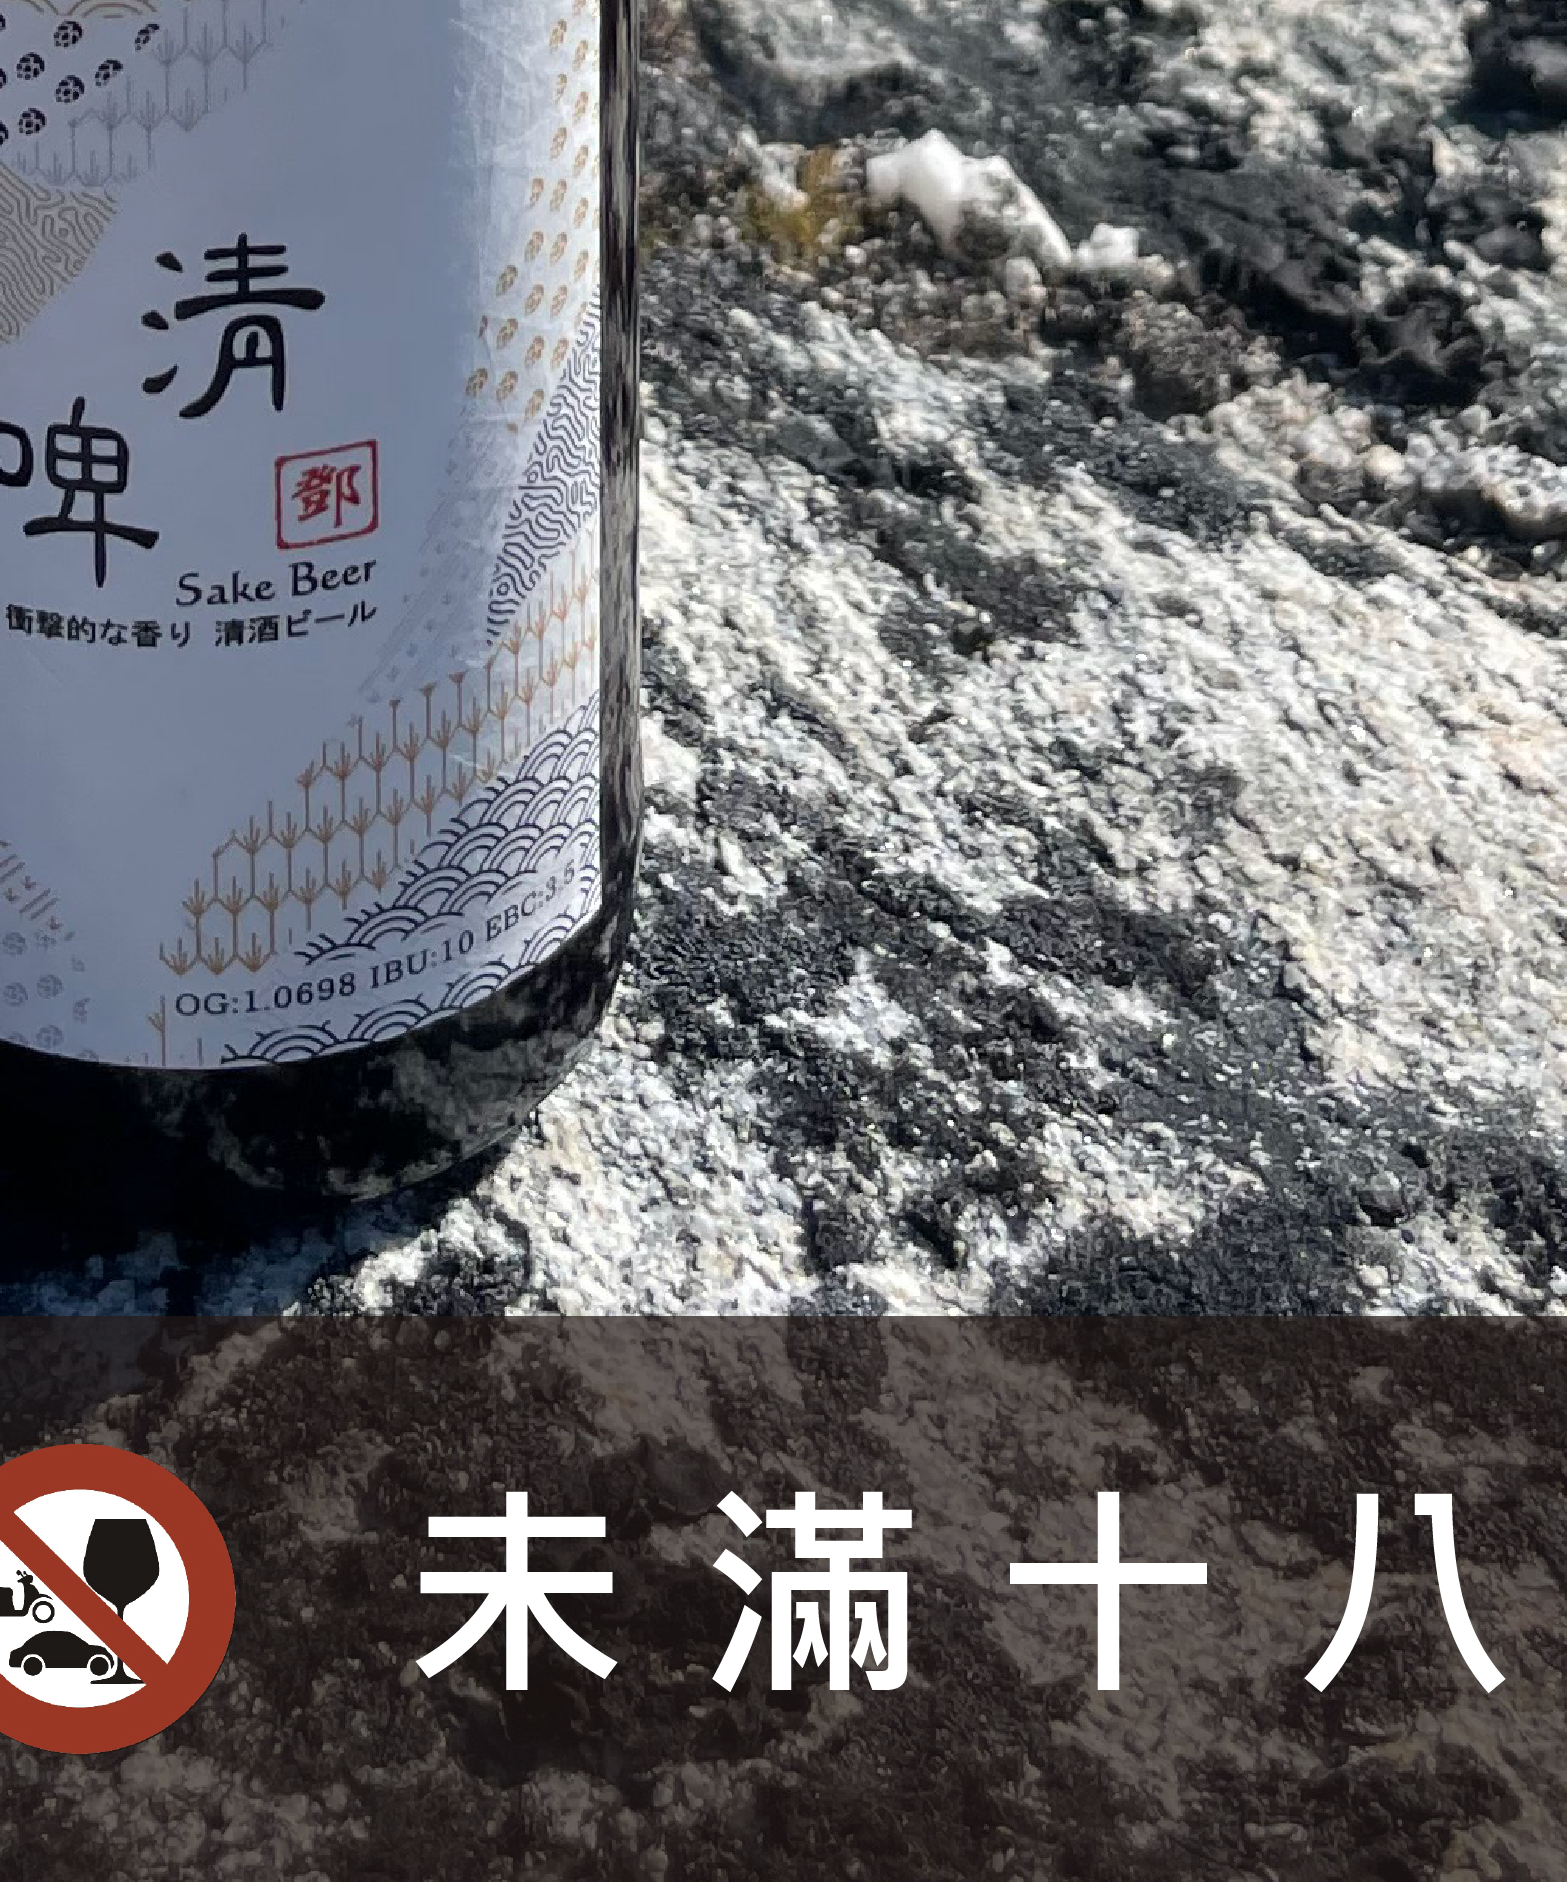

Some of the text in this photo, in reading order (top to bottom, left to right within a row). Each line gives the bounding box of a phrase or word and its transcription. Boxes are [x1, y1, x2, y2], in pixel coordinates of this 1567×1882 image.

[291, 463, 361, 529] 鄧
[176, 559, 377, 607] Sake Beer
[215, 599, 378, 647] 清酒ビール
[175, 971, 357, 1016] OG:1.0698
[371, 928, 475, 990] IBU:10
